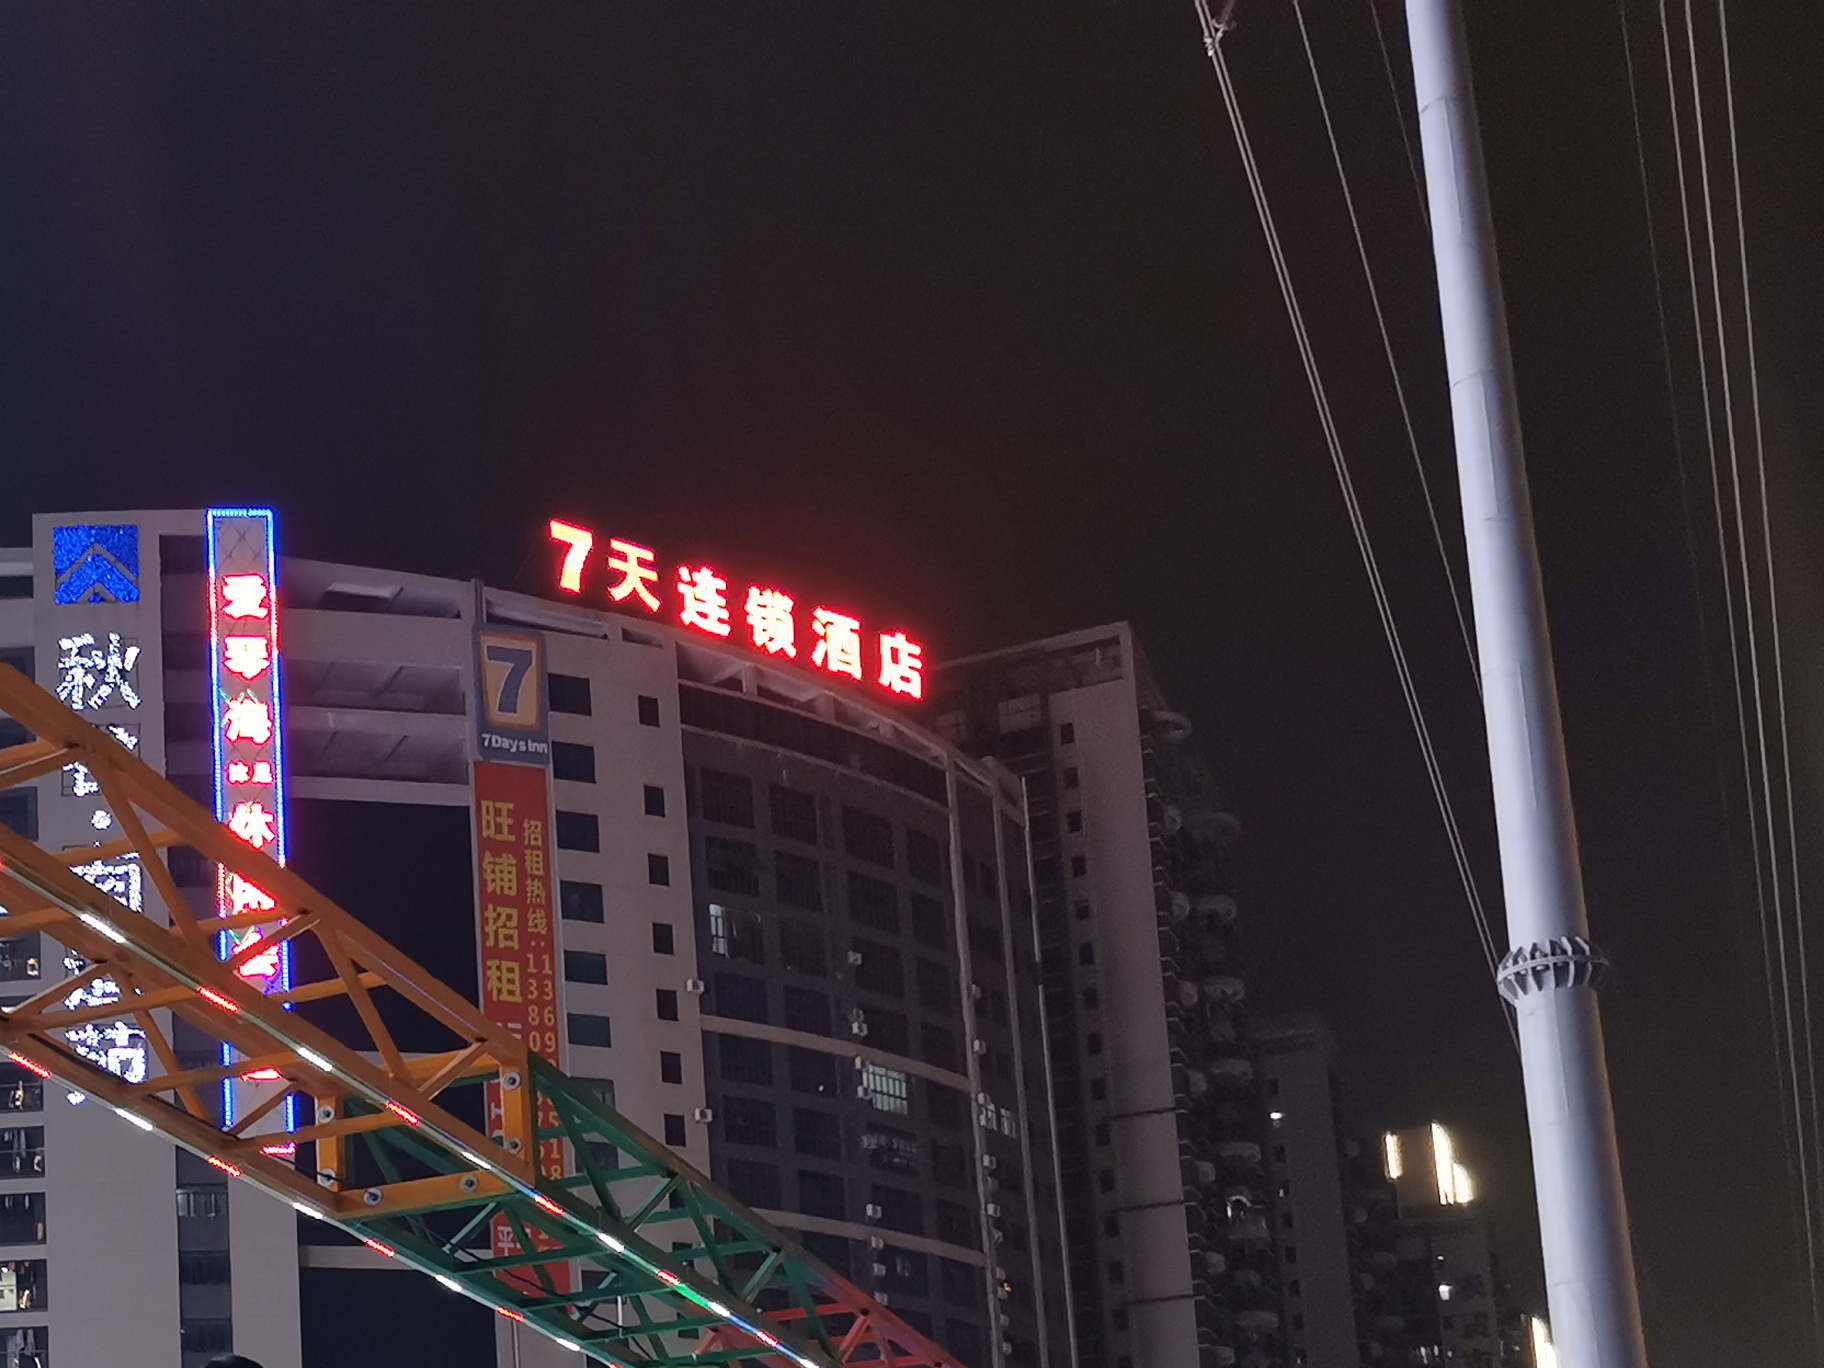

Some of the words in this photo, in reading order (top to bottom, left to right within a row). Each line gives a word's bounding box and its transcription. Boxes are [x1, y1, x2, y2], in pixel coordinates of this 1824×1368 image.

[486, 645, 533, 714] 7
[548, 517, 926, 700] 7天连锁酒店
[480, 799, 523, 1004] 旺铺招租
